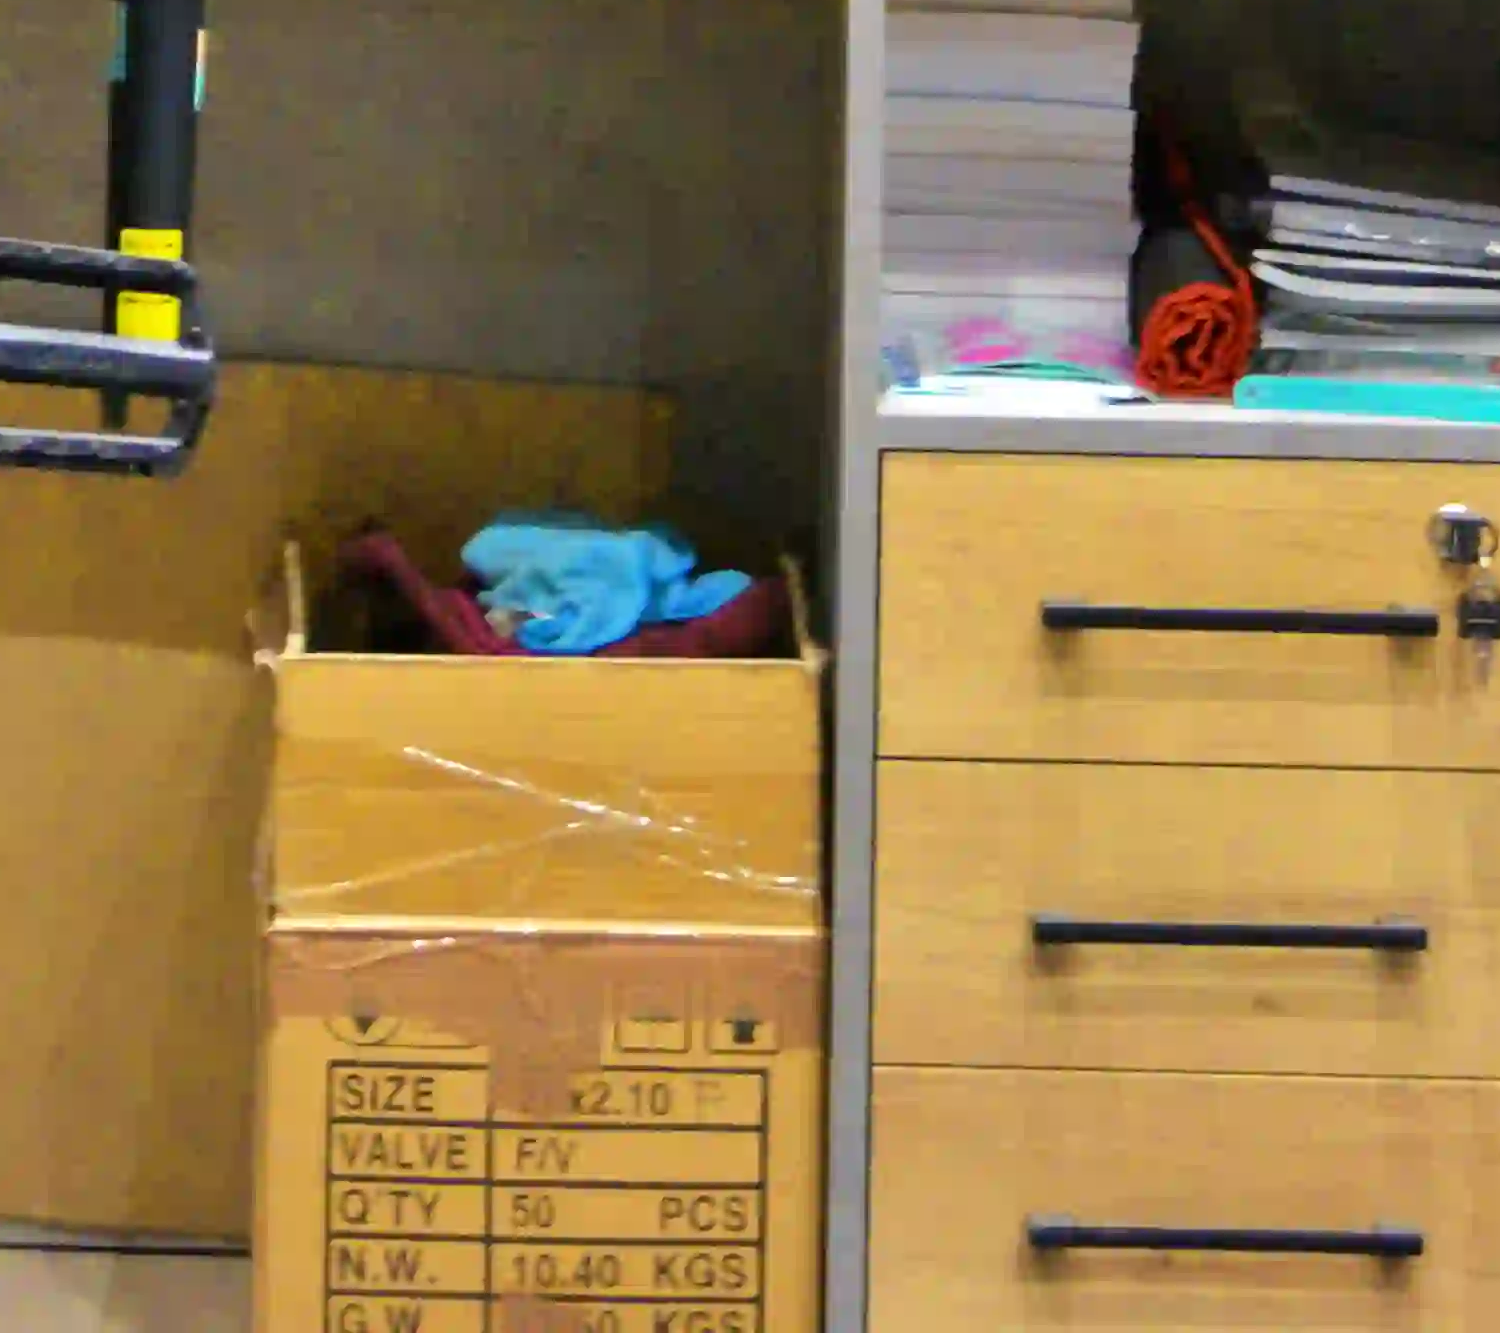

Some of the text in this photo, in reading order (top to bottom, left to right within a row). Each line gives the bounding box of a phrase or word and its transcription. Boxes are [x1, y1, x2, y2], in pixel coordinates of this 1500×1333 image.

[340, 1074, 436, 1114] SIZE
[338, 1133, 580, 1174] VALVE F/V
[339, 1189, 750, 1233] Q'TY 50 PCS
[337, 1244, 750, 1290] N.W. 10.40 KGS
[652, 1309, 747, 1333] KGS
